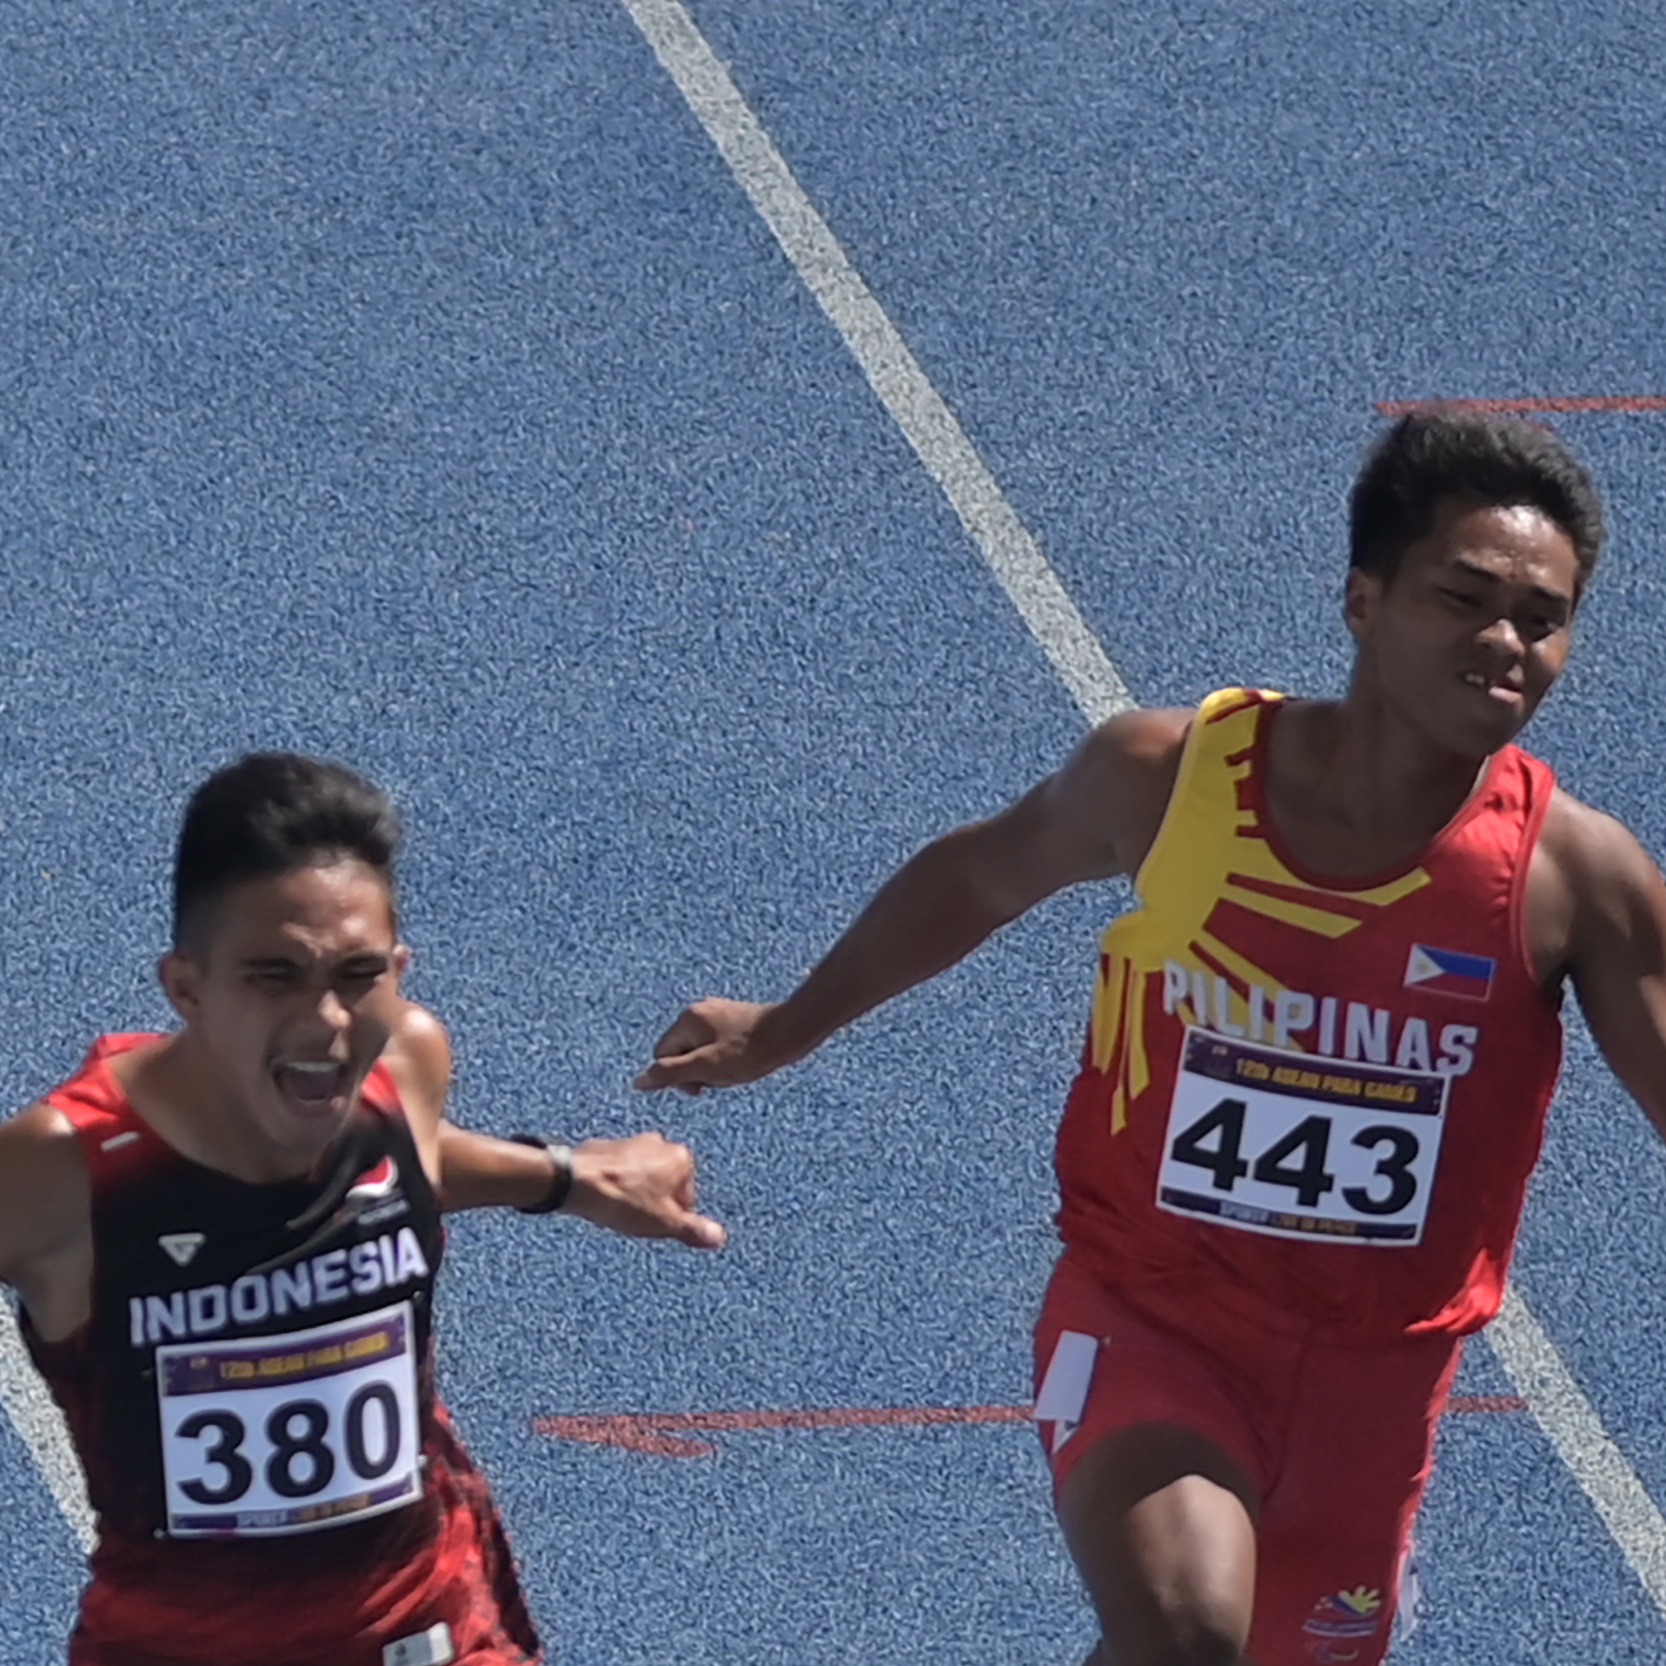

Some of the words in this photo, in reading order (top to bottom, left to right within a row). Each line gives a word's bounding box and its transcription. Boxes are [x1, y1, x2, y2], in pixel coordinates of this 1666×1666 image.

[1162, 958, 1479, 1076] PILIPINAS
[1171, 1098, 1421, 1215] 443
[130, 1227, 429, 1348] INDONESIA
[175, 1380, 402, 1505] 380
